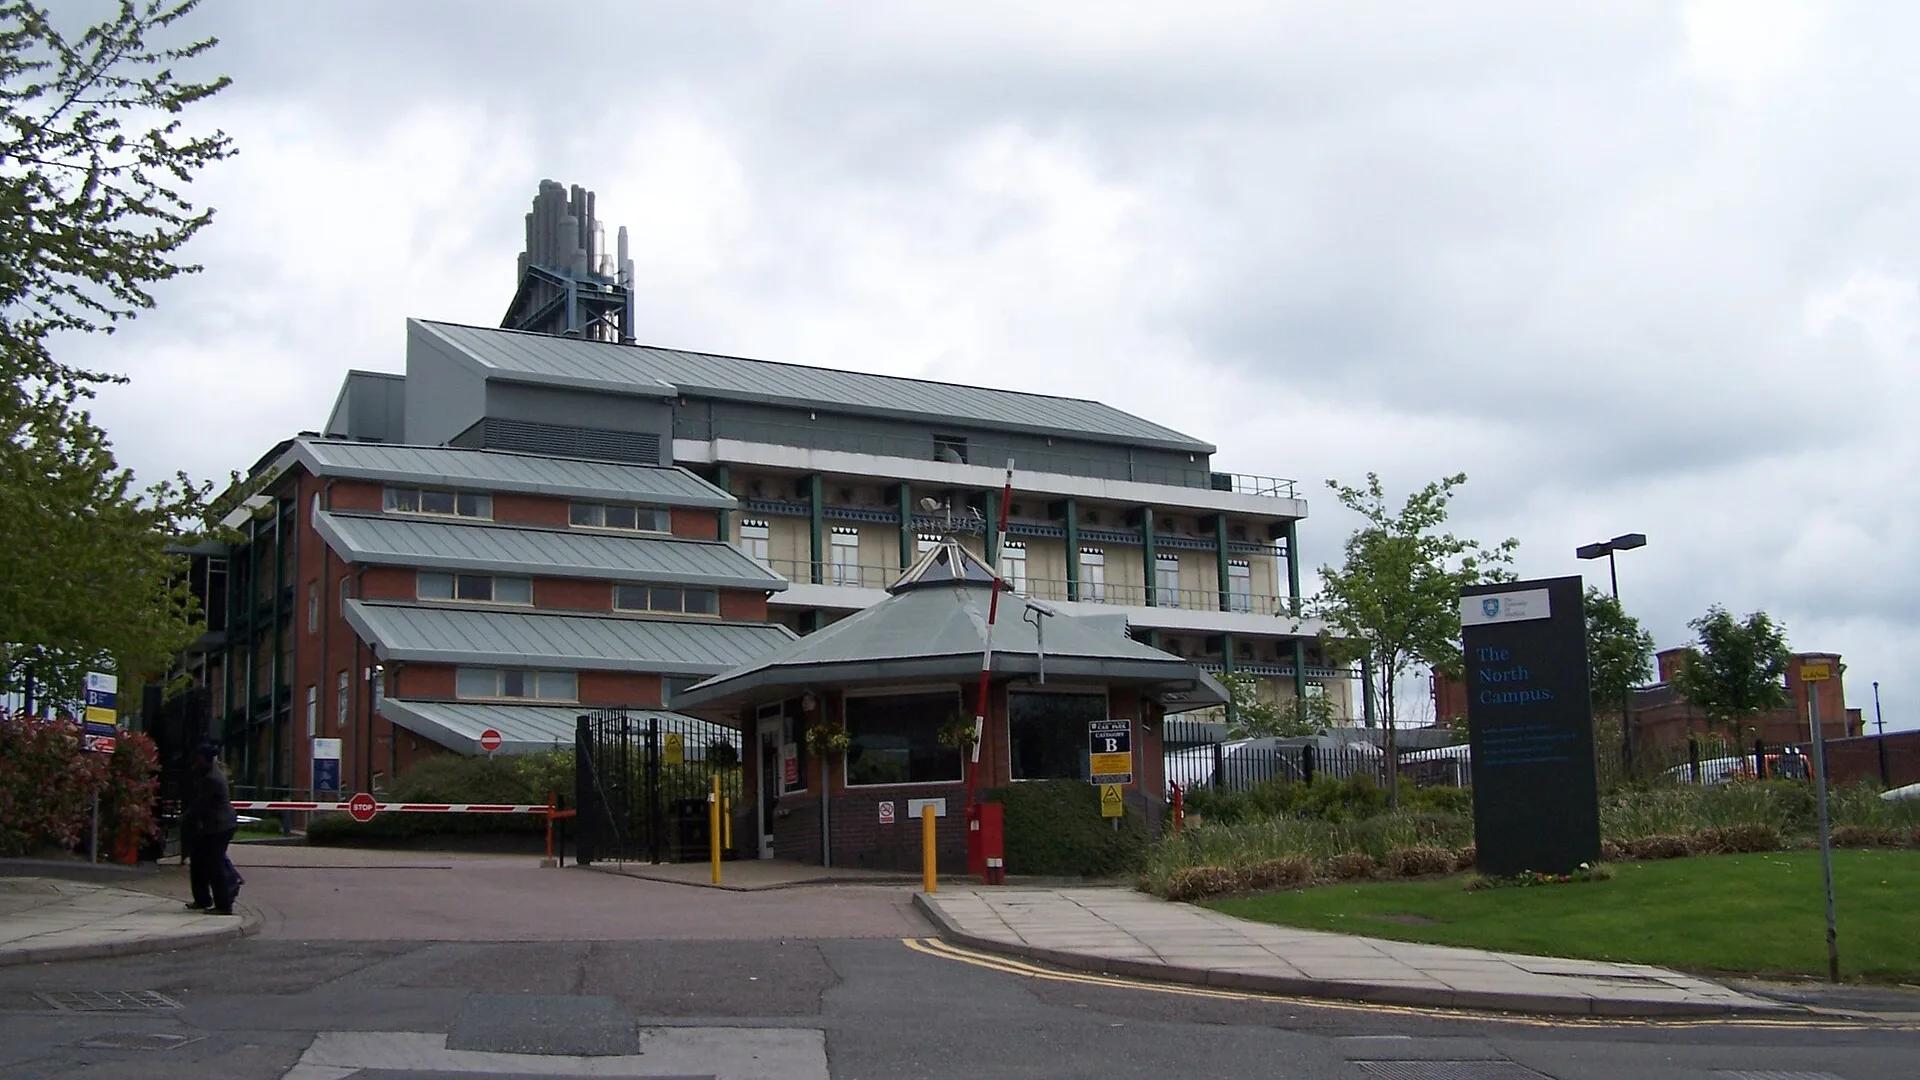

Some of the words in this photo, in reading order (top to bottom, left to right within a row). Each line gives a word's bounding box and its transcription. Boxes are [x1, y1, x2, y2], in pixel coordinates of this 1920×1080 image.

[1477, 647, 1509, 661] The
[1480, 665, 1529, 682] North
[89, 691, 98, 705] B
[1105, 738, 1118, 752] B
[353, 803, 373, 811] STOP
